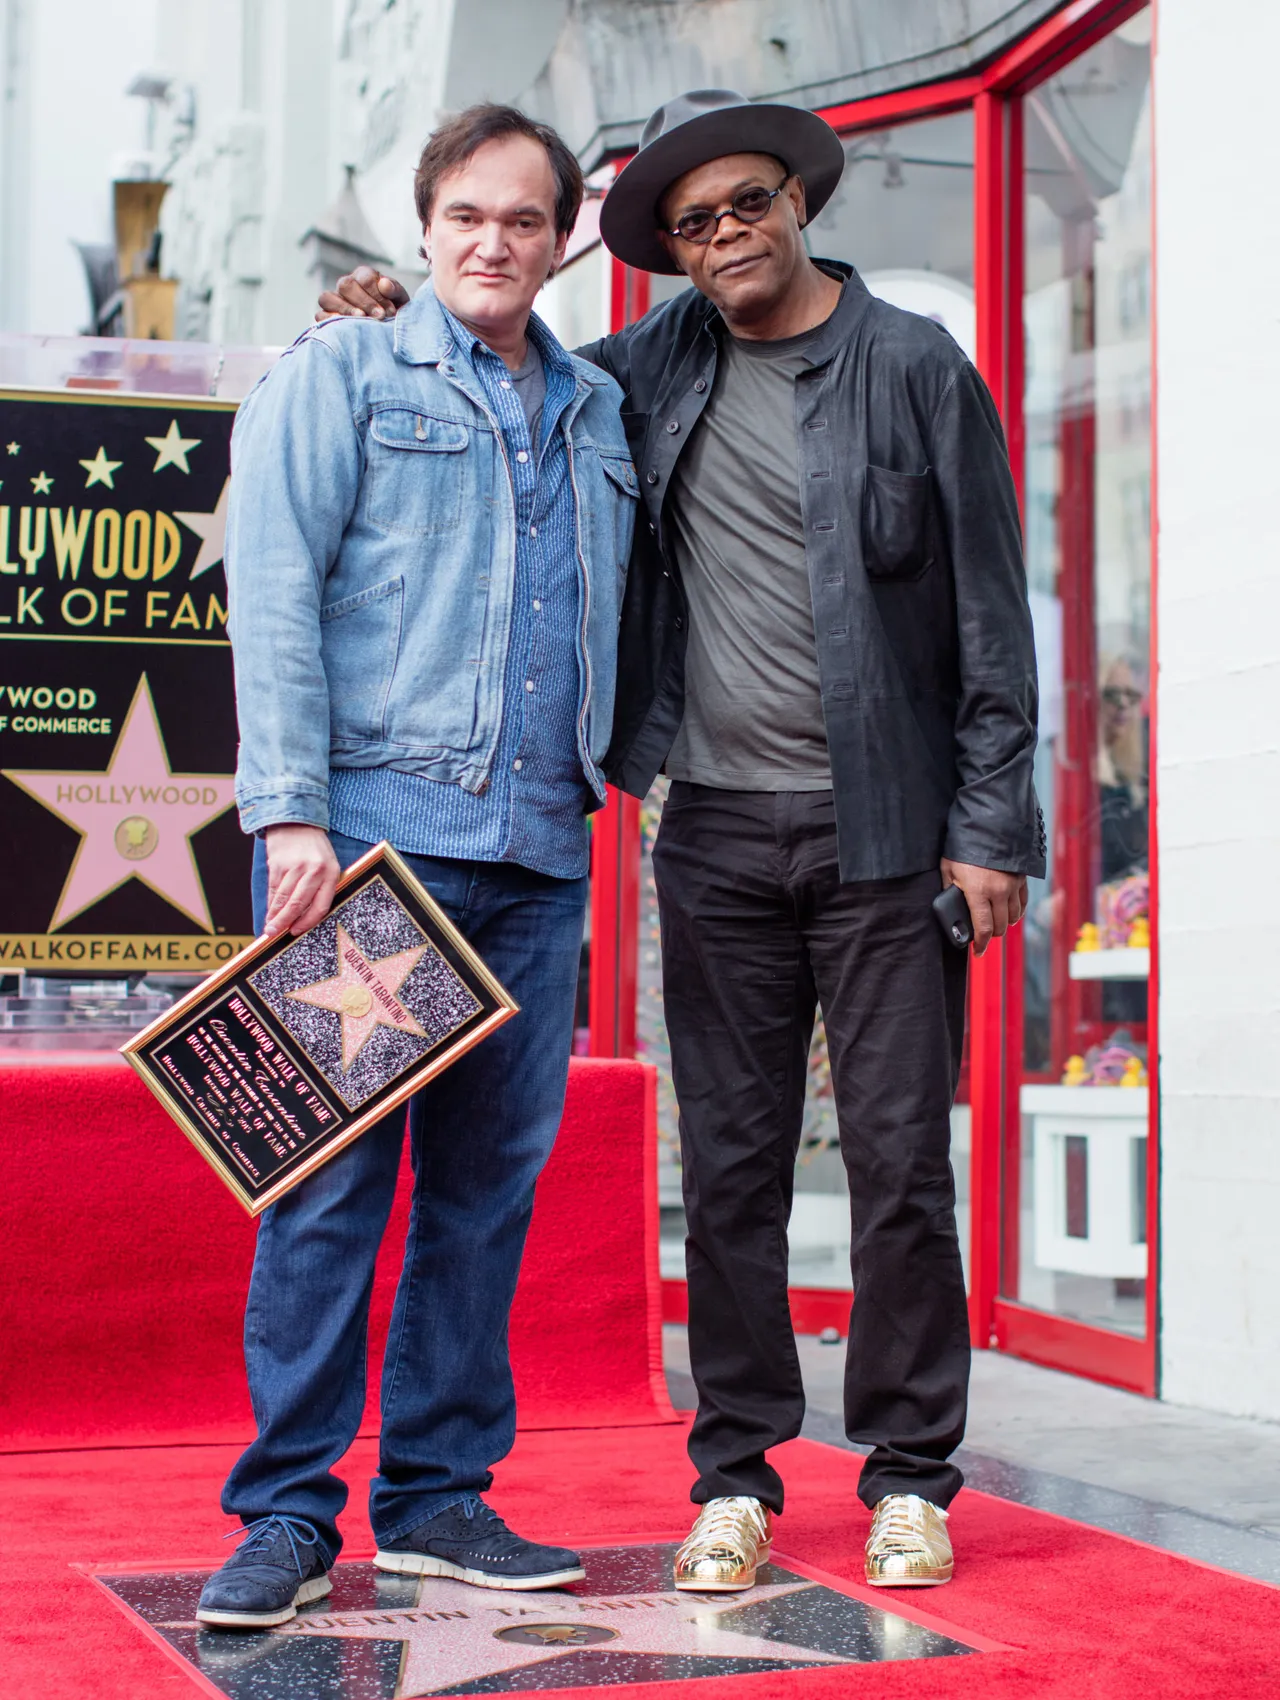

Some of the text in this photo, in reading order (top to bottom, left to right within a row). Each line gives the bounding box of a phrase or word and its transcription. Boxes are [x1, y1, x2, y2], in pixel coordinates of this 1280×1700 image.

[61, 588, 129, 627] OF
[11, 716, 112, 735] COMMERCE
[56, 784, 218, 805] HOLLYWOOD
[0, 940, 245, 961] ALKOFFAME.CO
[344, 948, 408, 1024] QUENTIN TARANTINO
[186, 1034, 288, 1158] HOLLYWOOD WALK OF FAME
[209, 1019, 306, 1139] Quentin Tarantino
[228, 997, 332, 1124] HOLLYWOOD WALK OF FAME
[162, 1054, 260, 1178] HOLLYWOOD CHAMBER OF COMMERCE
